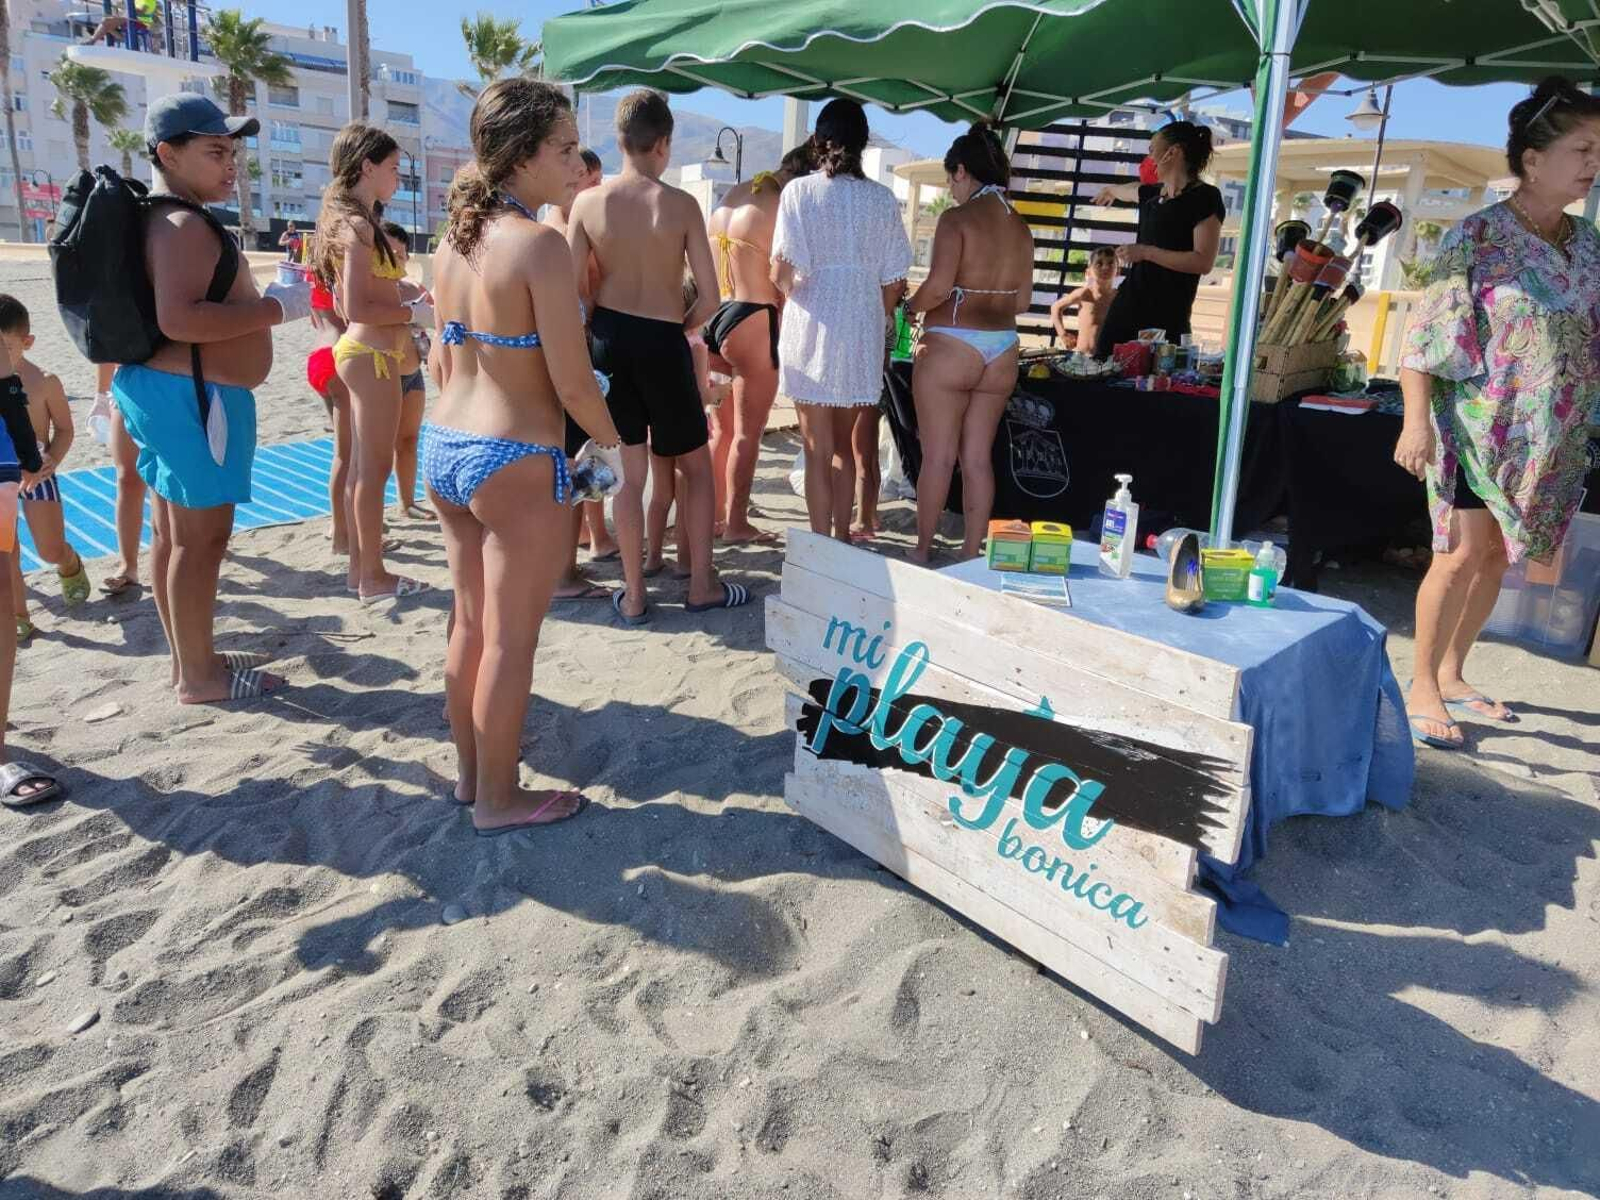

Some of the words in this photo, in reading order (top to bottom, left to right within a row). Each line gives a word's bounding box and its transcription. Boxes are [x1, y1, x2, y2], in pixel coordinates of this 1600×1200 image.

[823, 616, 891, 669] mi
[810, 640, 1114, 850] playa
[997, 817, 1149, 929] bonica
